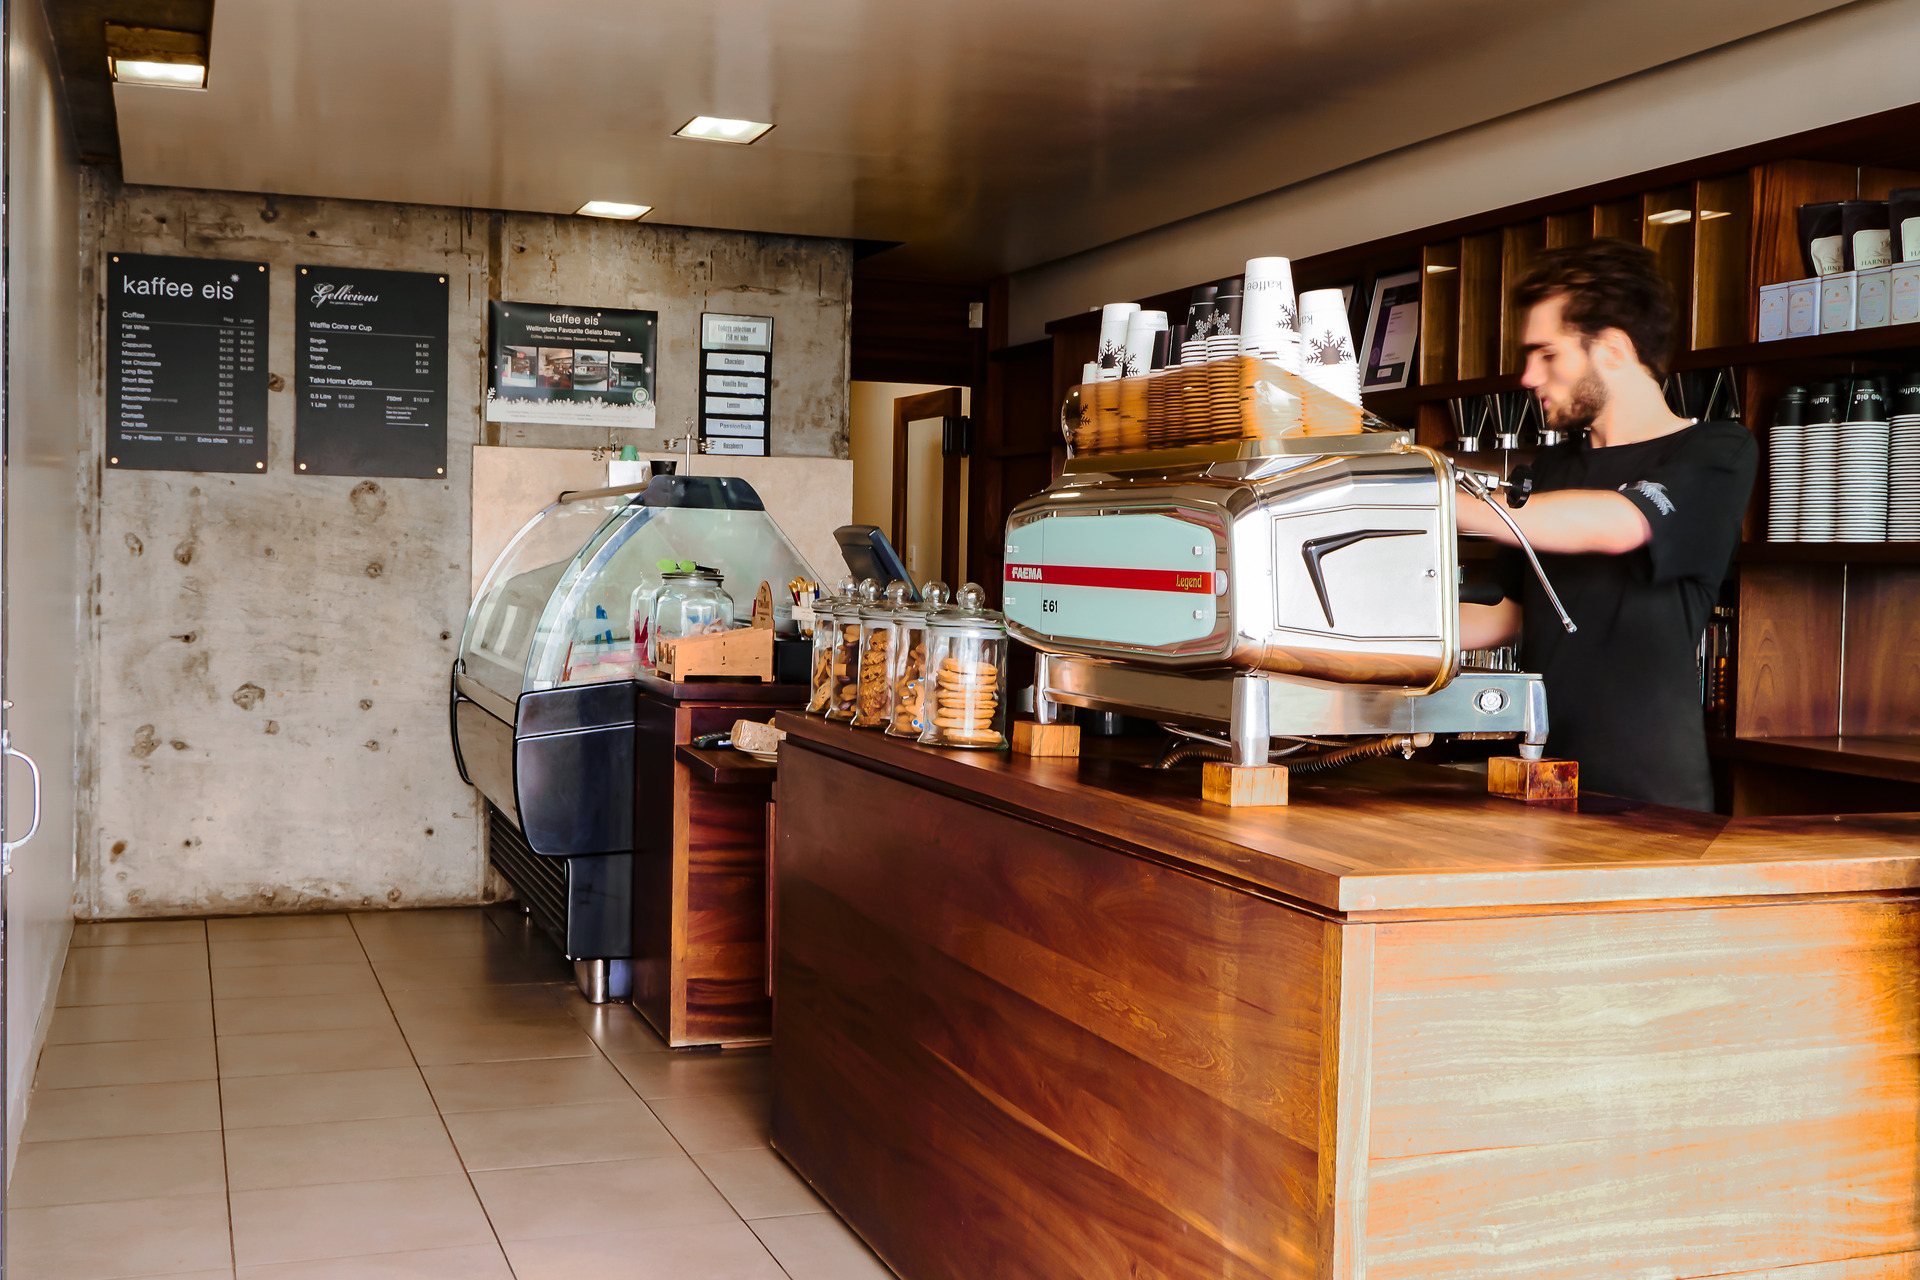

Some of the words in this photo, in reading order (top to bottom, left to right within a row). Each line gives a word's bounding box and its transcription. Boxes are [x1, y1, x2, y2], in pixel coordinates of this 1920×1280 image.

[123, 275, 193, 297] kaffee
[202, 280, 234, 300] eis
[1246, 280, 1282, 291] kaffee
[311, 283, 378, 308] Gellicious
[550, 314, 580, 324] kaffee
[584, 316, 599, 326] eis
[526, 325, 558, 334] Wellingtons
[1012, 566, 1042, 580] FAEMA
[1176, 574, 1202, 590] Legend
[1043, 600, 1048, 612] E
[1049, 600, 1058, 613] 61
